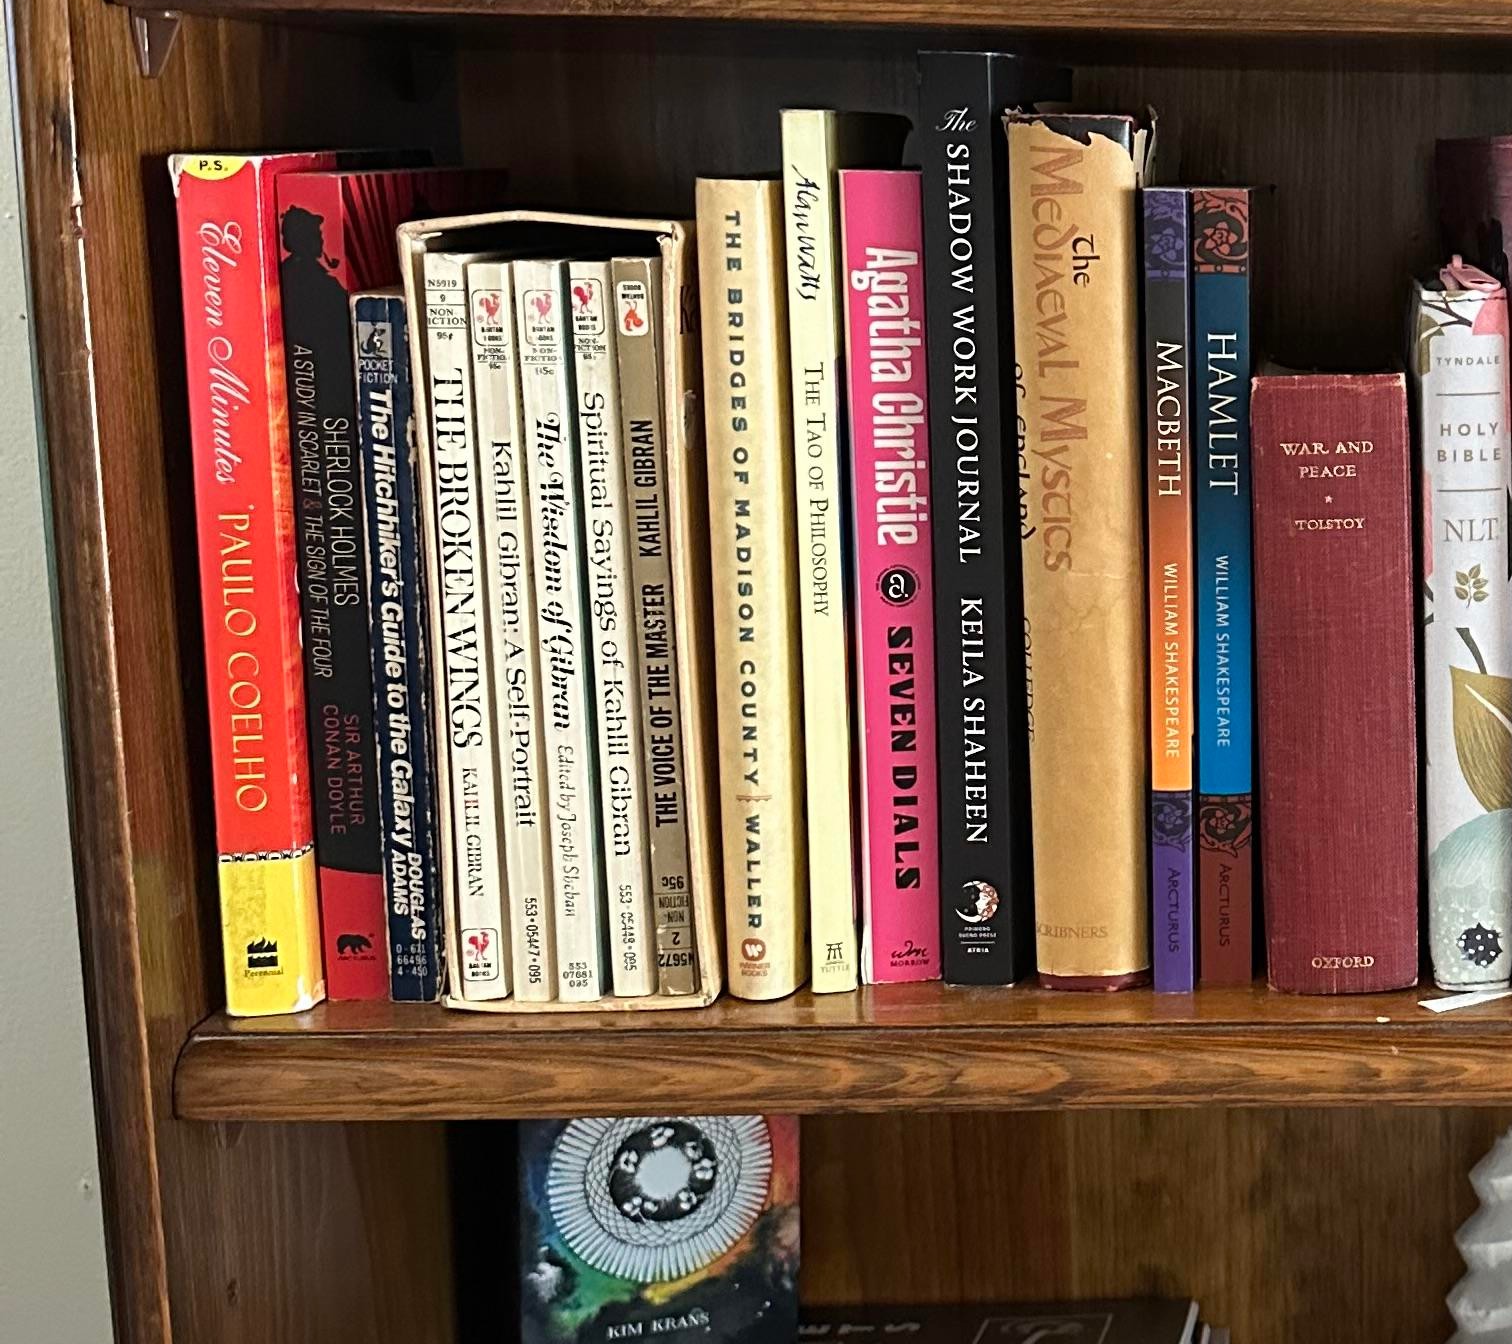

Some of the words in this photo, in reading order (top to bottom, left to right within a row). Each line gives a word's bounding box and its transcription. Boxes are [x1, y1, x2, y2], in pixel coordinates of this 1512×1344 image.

[199, 159, 228, 171] P.S.
[197, 220, 243, 328] Eleven
[1437, 357, 1499, 365] TYNDALE
[207, 335, 250, 485] Minutes
[1156, 341, 1183, 497] MACBETH
[1440, 424, 1499, 436] HOLY
[1281, 443, 1328, 455] WAR
[1336, 441, 1373, 454] AND
[1299, 465, 1357, 478] PEACE
[1437, 449, 1501, 462] BIBLE
[1295, 518, 1364, 530] TOLSTOY
[216, 506, 258, 637] PAULO
[1163, 563, 1178, 637] WILLIAM
[887, 626, 917, 753] SEVEN
[1163, 643, 1180, 758] SHAKESPEARE
[227, 653, 268, 813] COELHO
[891, 765, 921, 890] DIALS
[1312, 956, 1374, 969] OXFORD
[607, 1324, 643, 1339] KIM
[653, 1311, 710, 1331] KRANS
